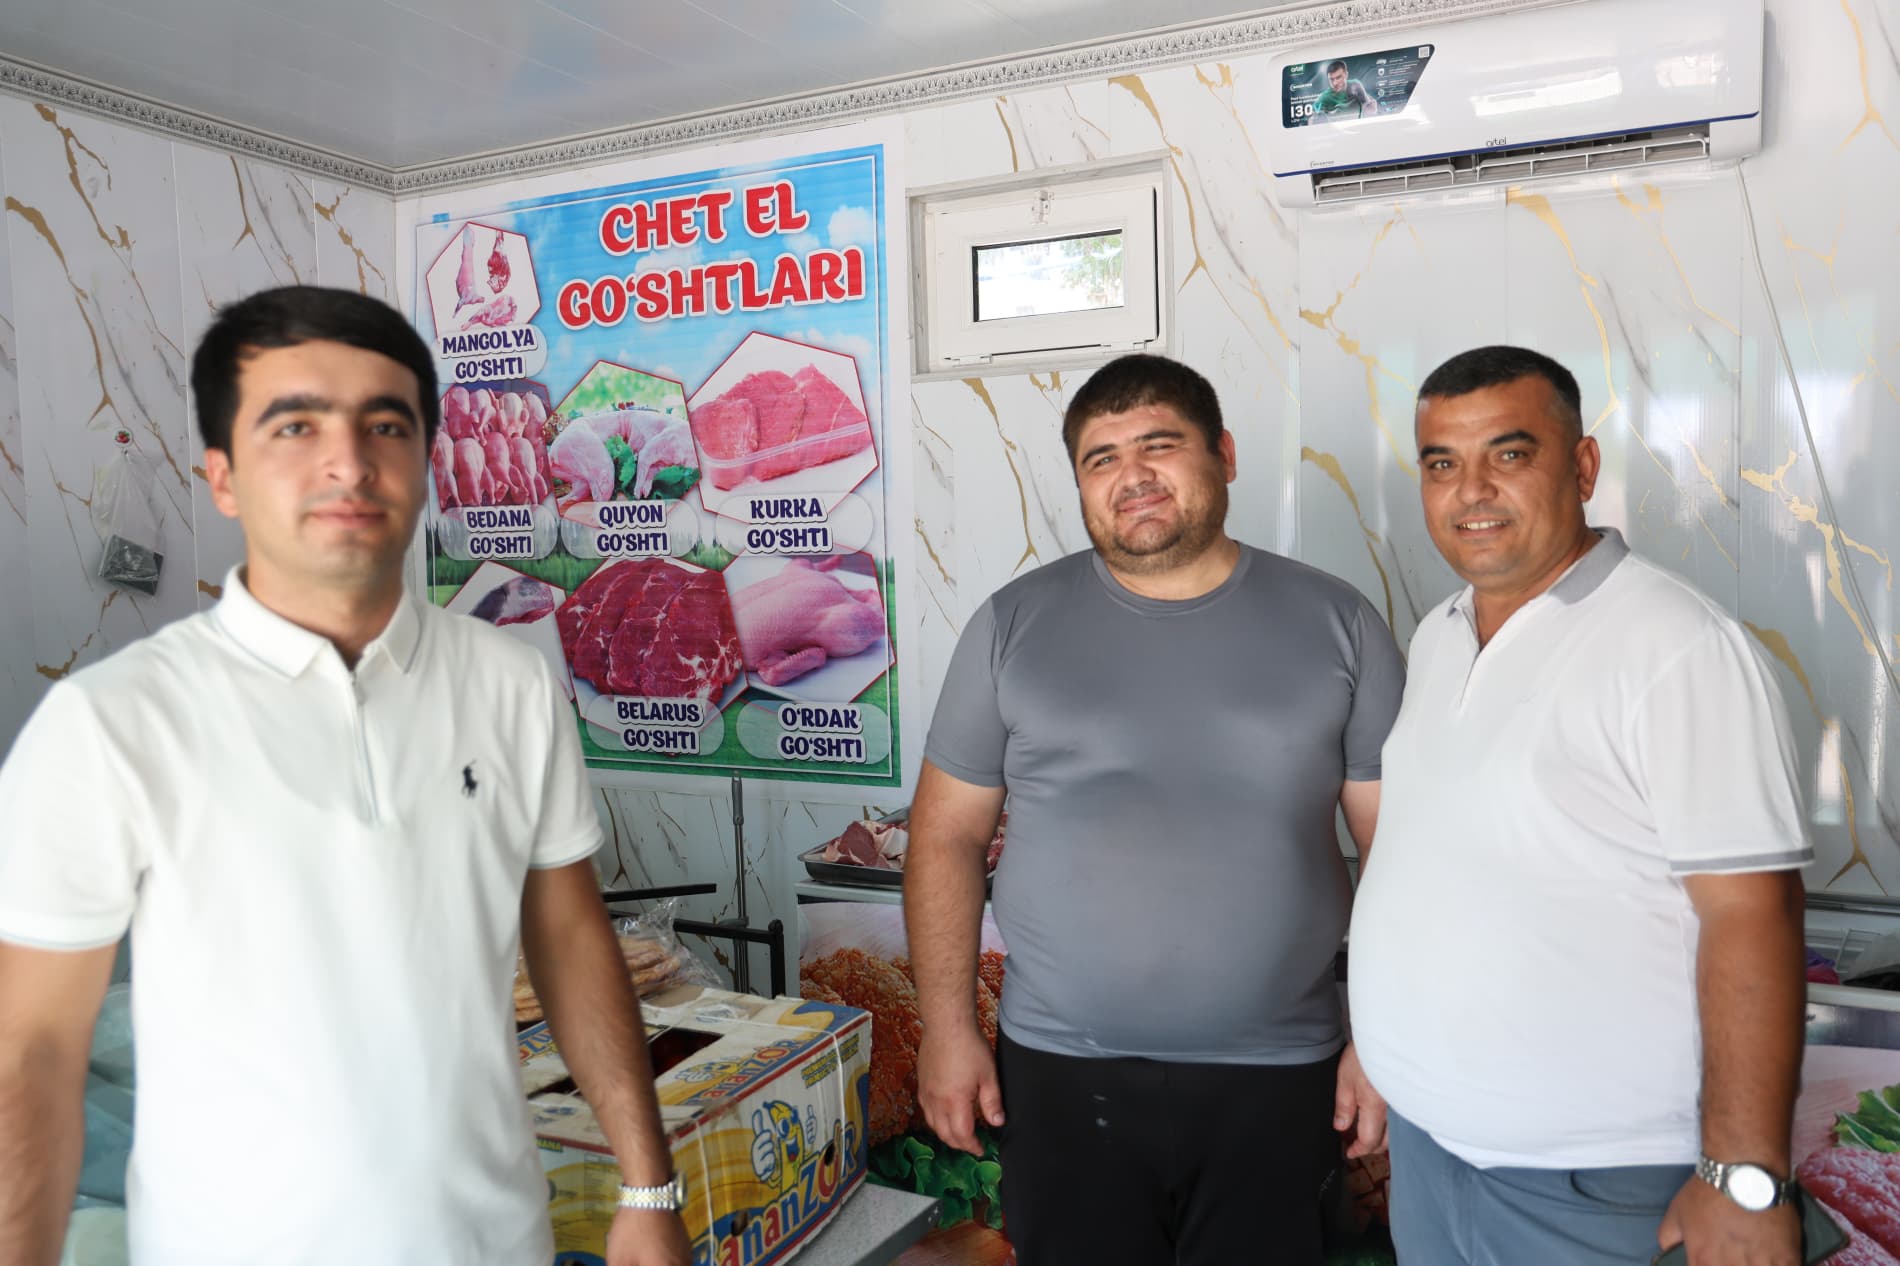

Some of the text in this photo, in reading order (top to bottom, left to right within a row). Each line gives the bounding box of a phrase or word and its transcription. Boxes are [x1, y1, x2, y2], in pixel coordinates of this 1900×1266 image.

[601, 182, 808, 254] CHET EL
[558, 248, 863, 328] GO‘SHTLARI
[442, 328, 535, 354] MANGOLYA
[455, 356, 523, 379] GO‘SHTI
[466, 508, 532, 529] BEDANA
[598, 504, 664, 527] QUYON
[750, 497, 823, 519] KURKA
[469, 535, 532, 555] GO‘SHTI
[596, 533, 669, 553] GO‘SHTI
[746, 526, 829, 549] GO‘SHTI
[617, 701, 701, 723] BELARUS
[781, 707, 859, 729] O‘RDAK
[623, 729, 697, 751] GO‘SHTI
[780, 736, 862, 759] GO‘SHTI
